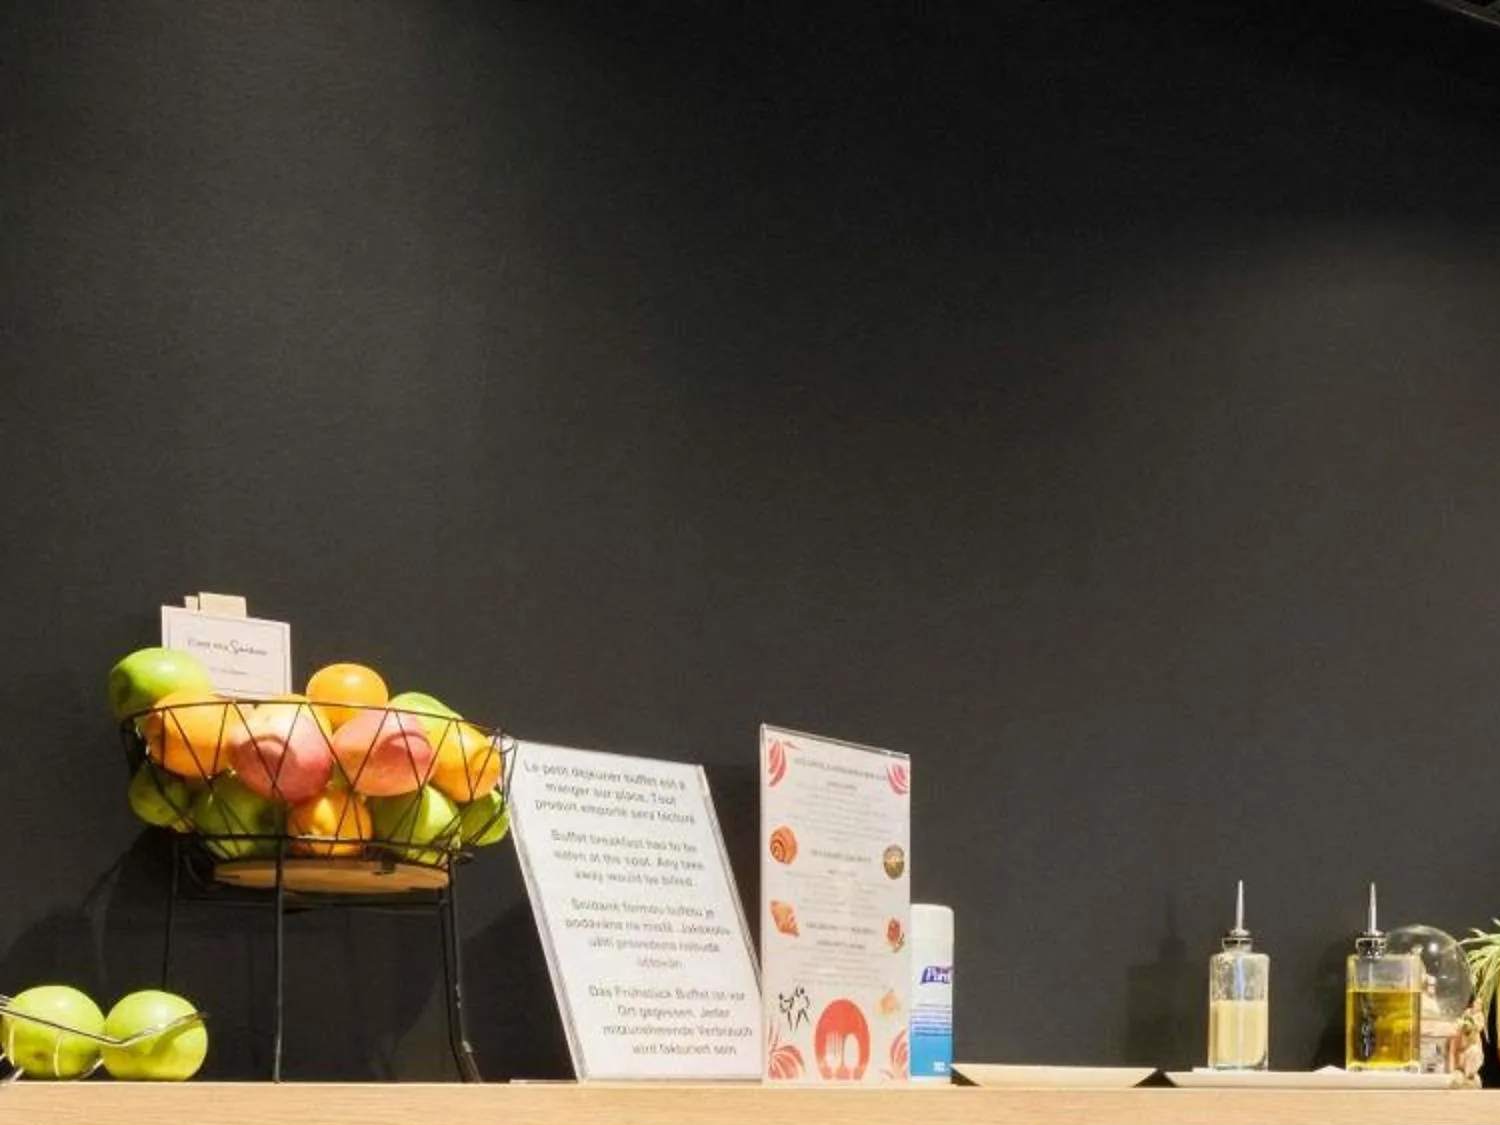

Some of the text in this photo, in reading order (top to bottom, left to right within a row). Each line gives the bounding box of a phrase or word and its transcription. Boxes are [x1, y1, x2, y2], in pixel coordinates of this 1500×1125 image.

[542, 764, 567, 777] petit
[624, 772, 657, 786] buffet
[659, 777, 677, 788] est
[546, 784, 590, 798] manger
[593, 788, 612, 798] sur
[652, 793, 676, 805] Tout
[535, 800, 577, 813] produit
[551, 829, 587, 843] Buffet
[589, 833, 644, 849] breakfast
[646, 839, 667, 851] has
[553, 850, 587, 862] eaten
[603, 854, 622, 865] the
[656, 859, 679, 871] Any
[574, 871, 603, 883] away
[607, 872, 643, 884] would
